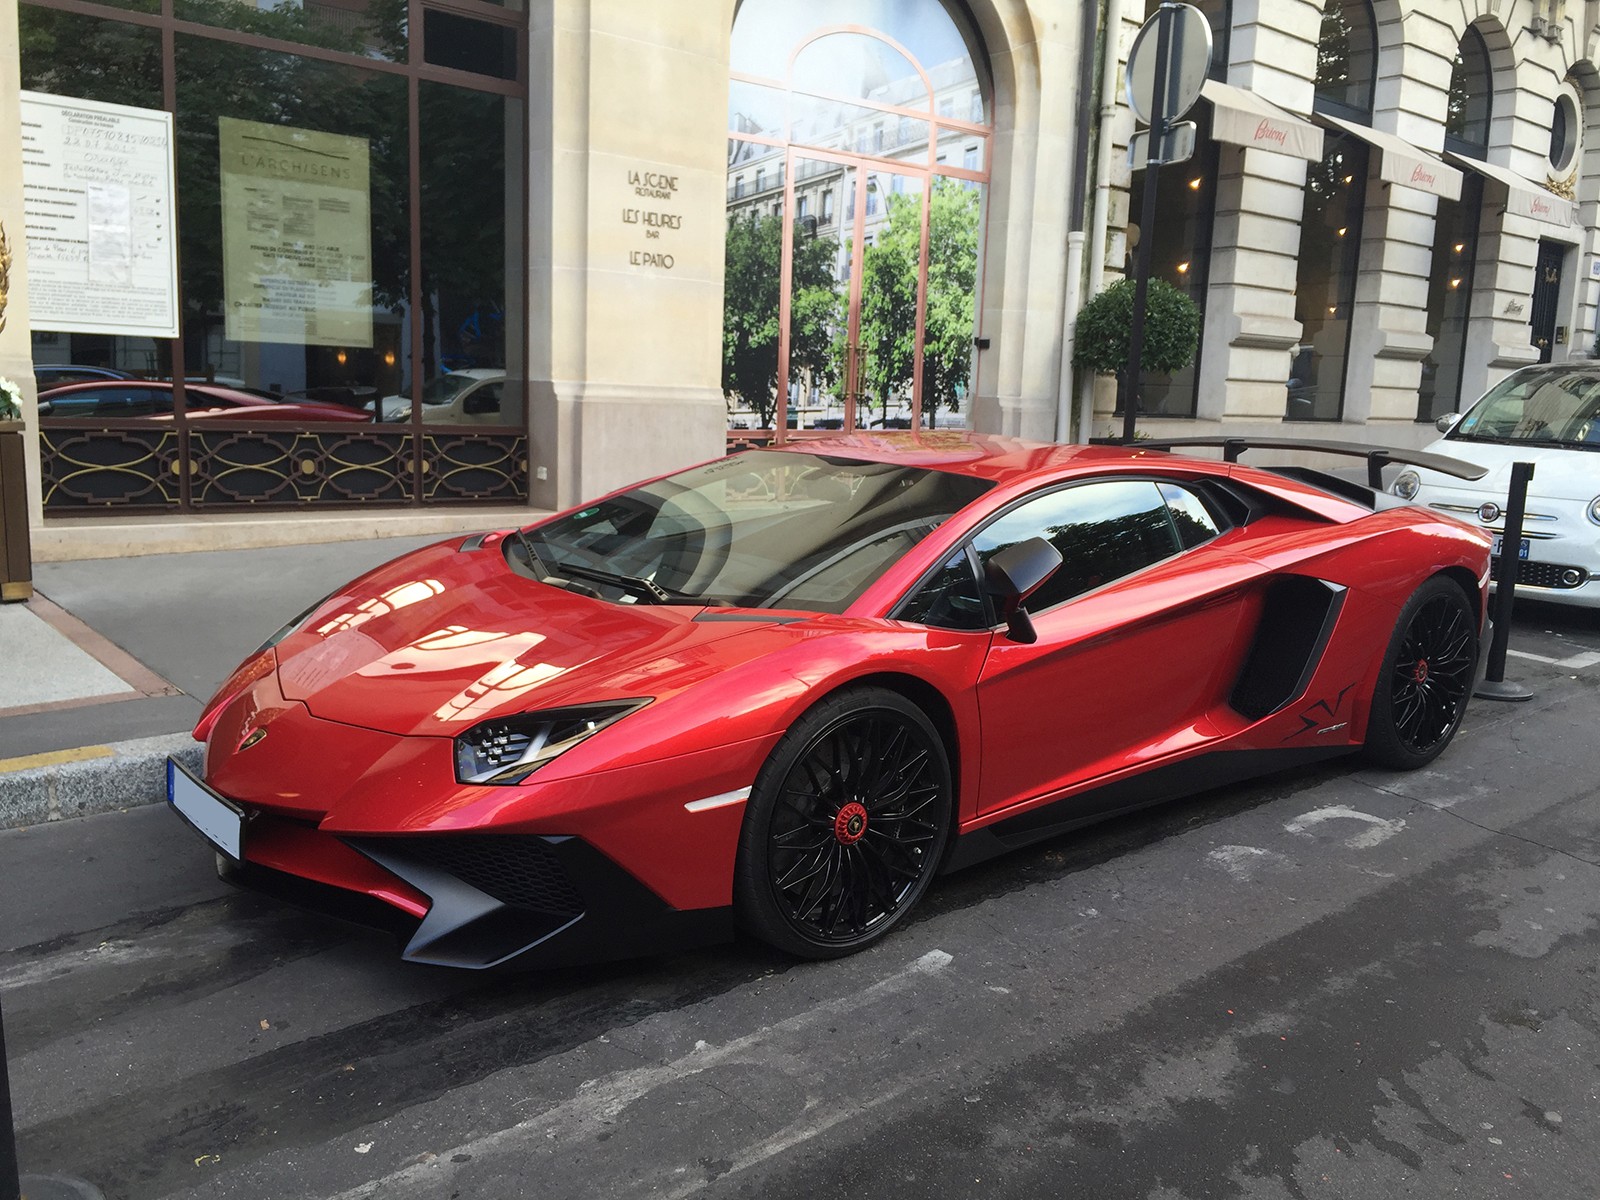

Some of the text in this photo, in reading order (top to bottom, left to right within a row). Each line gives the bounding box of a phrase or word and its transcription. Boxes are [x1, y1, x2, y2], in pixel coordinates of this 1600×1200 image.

[241, 155, 351, 180] L'ARCHISENS
[628, 170, 679, 192] LA SCENE
[622, 208, 683, 230] LES HEURES
[646, 229, 660, 239] BAR
[630, 251, 675, 269] LE PATIO
